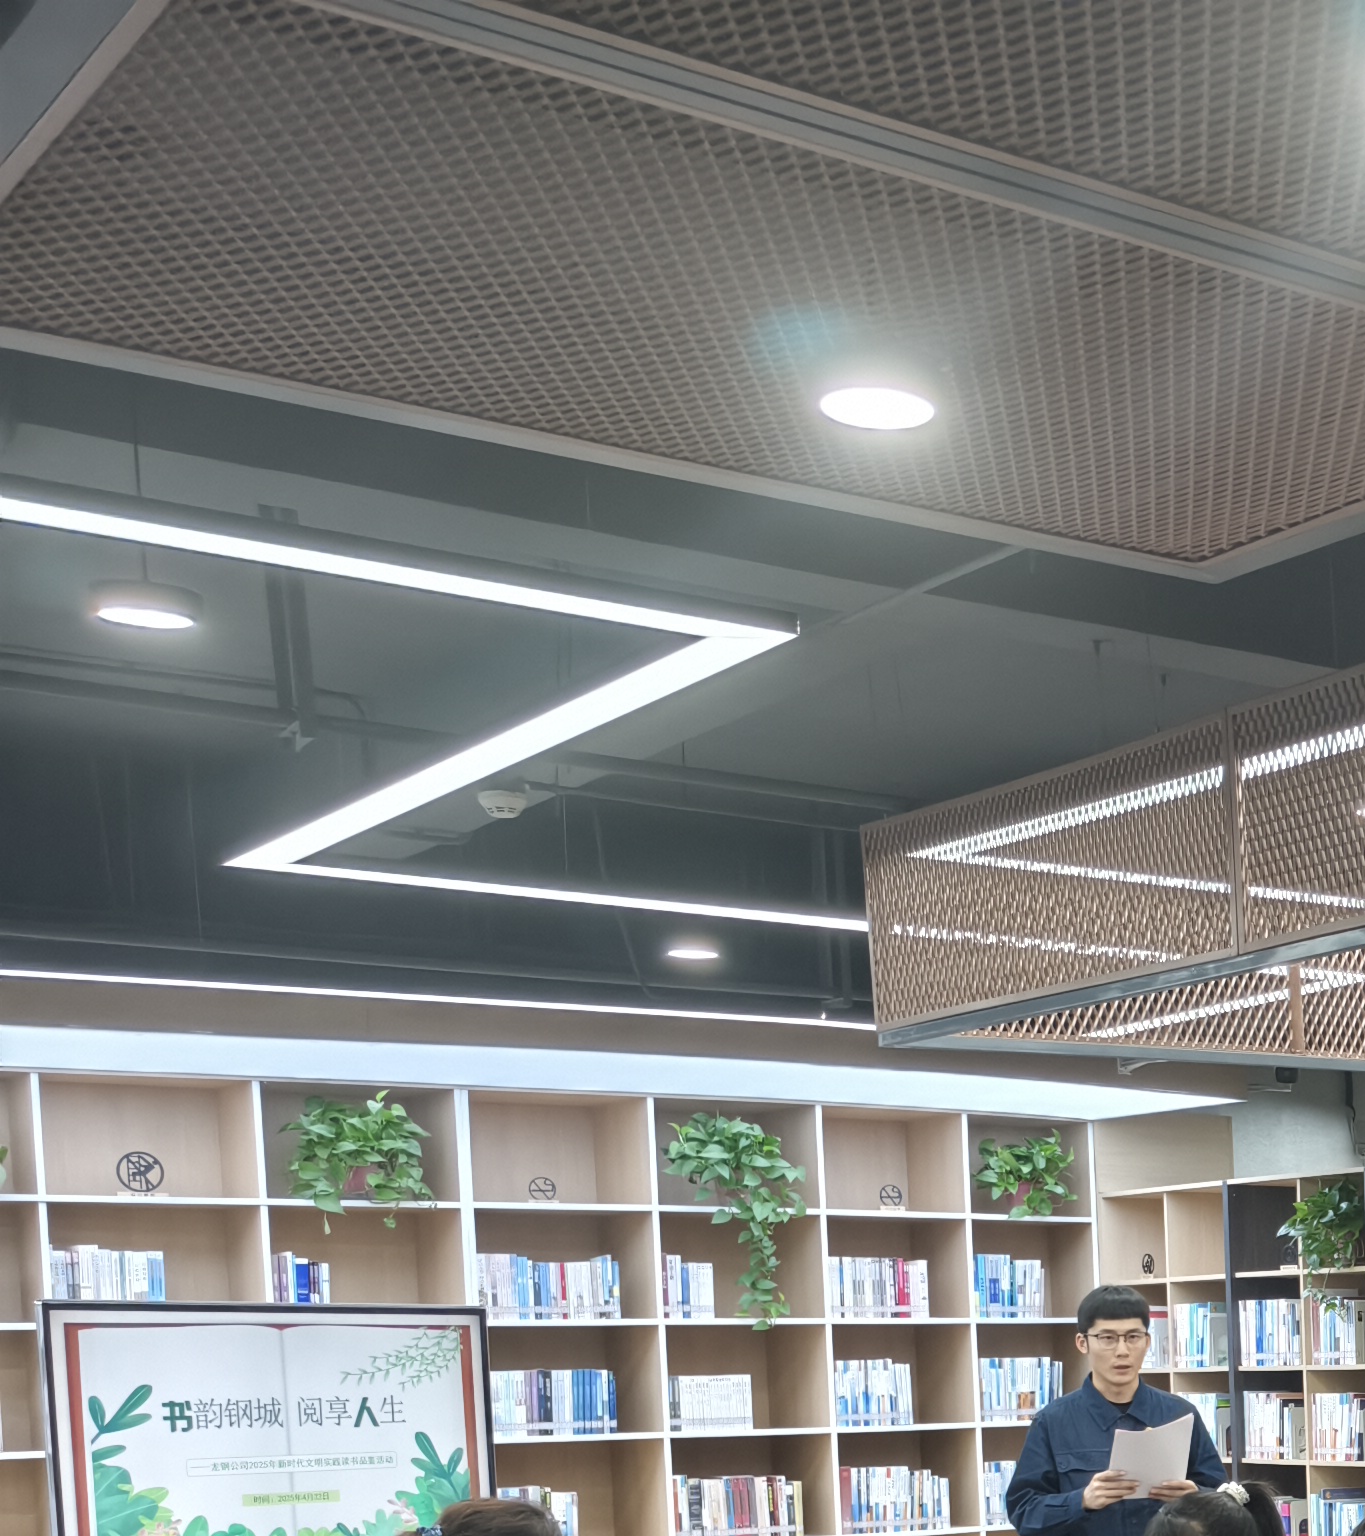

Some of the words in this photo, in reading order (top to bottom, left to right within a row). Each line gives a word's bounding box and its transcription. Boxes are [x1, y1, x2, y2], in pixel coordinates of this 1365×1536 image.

[161, 1396, 285, 1433] 书韵钢城
[297, 1395, 407, 1428] 阅享人生
